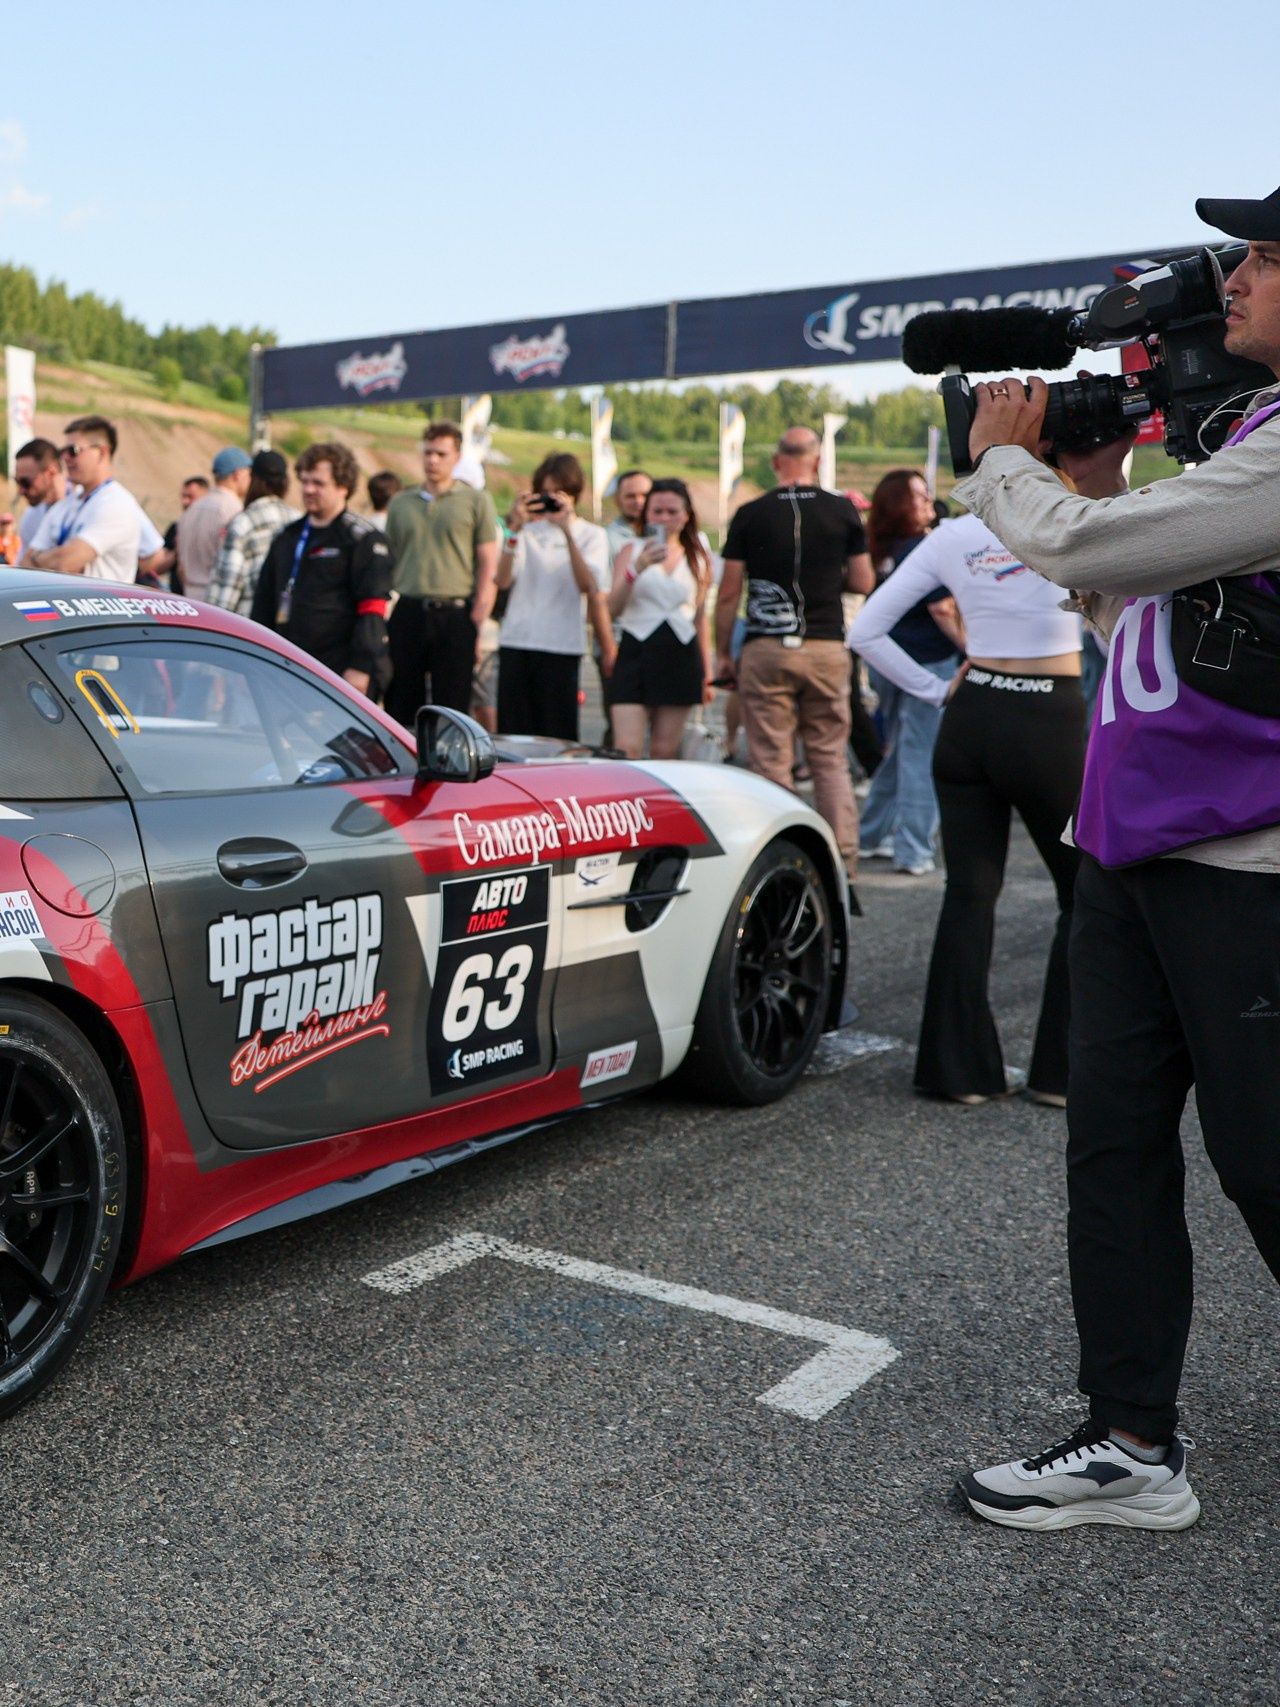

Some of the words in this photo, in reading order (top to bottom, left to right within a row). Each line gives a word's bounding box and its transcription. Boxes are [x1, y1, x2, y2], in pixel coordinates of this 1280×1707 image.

[51, 597, 200, 619] В.МЕЩЕРЯКОВ
[965, 668, 993, 686] SMP
[990, 675, 1055, 693] RACING
[453, 795, 654, 867] Самара-Моторс
[471, 875, 528, 913] АВТО
[466, 908, 508, 934] ПЛЮС
[441, 944, 534, 1043] 63
[462, 1049, 486, 1072] SMP
[485, 1039, 525, 1065] RACING
